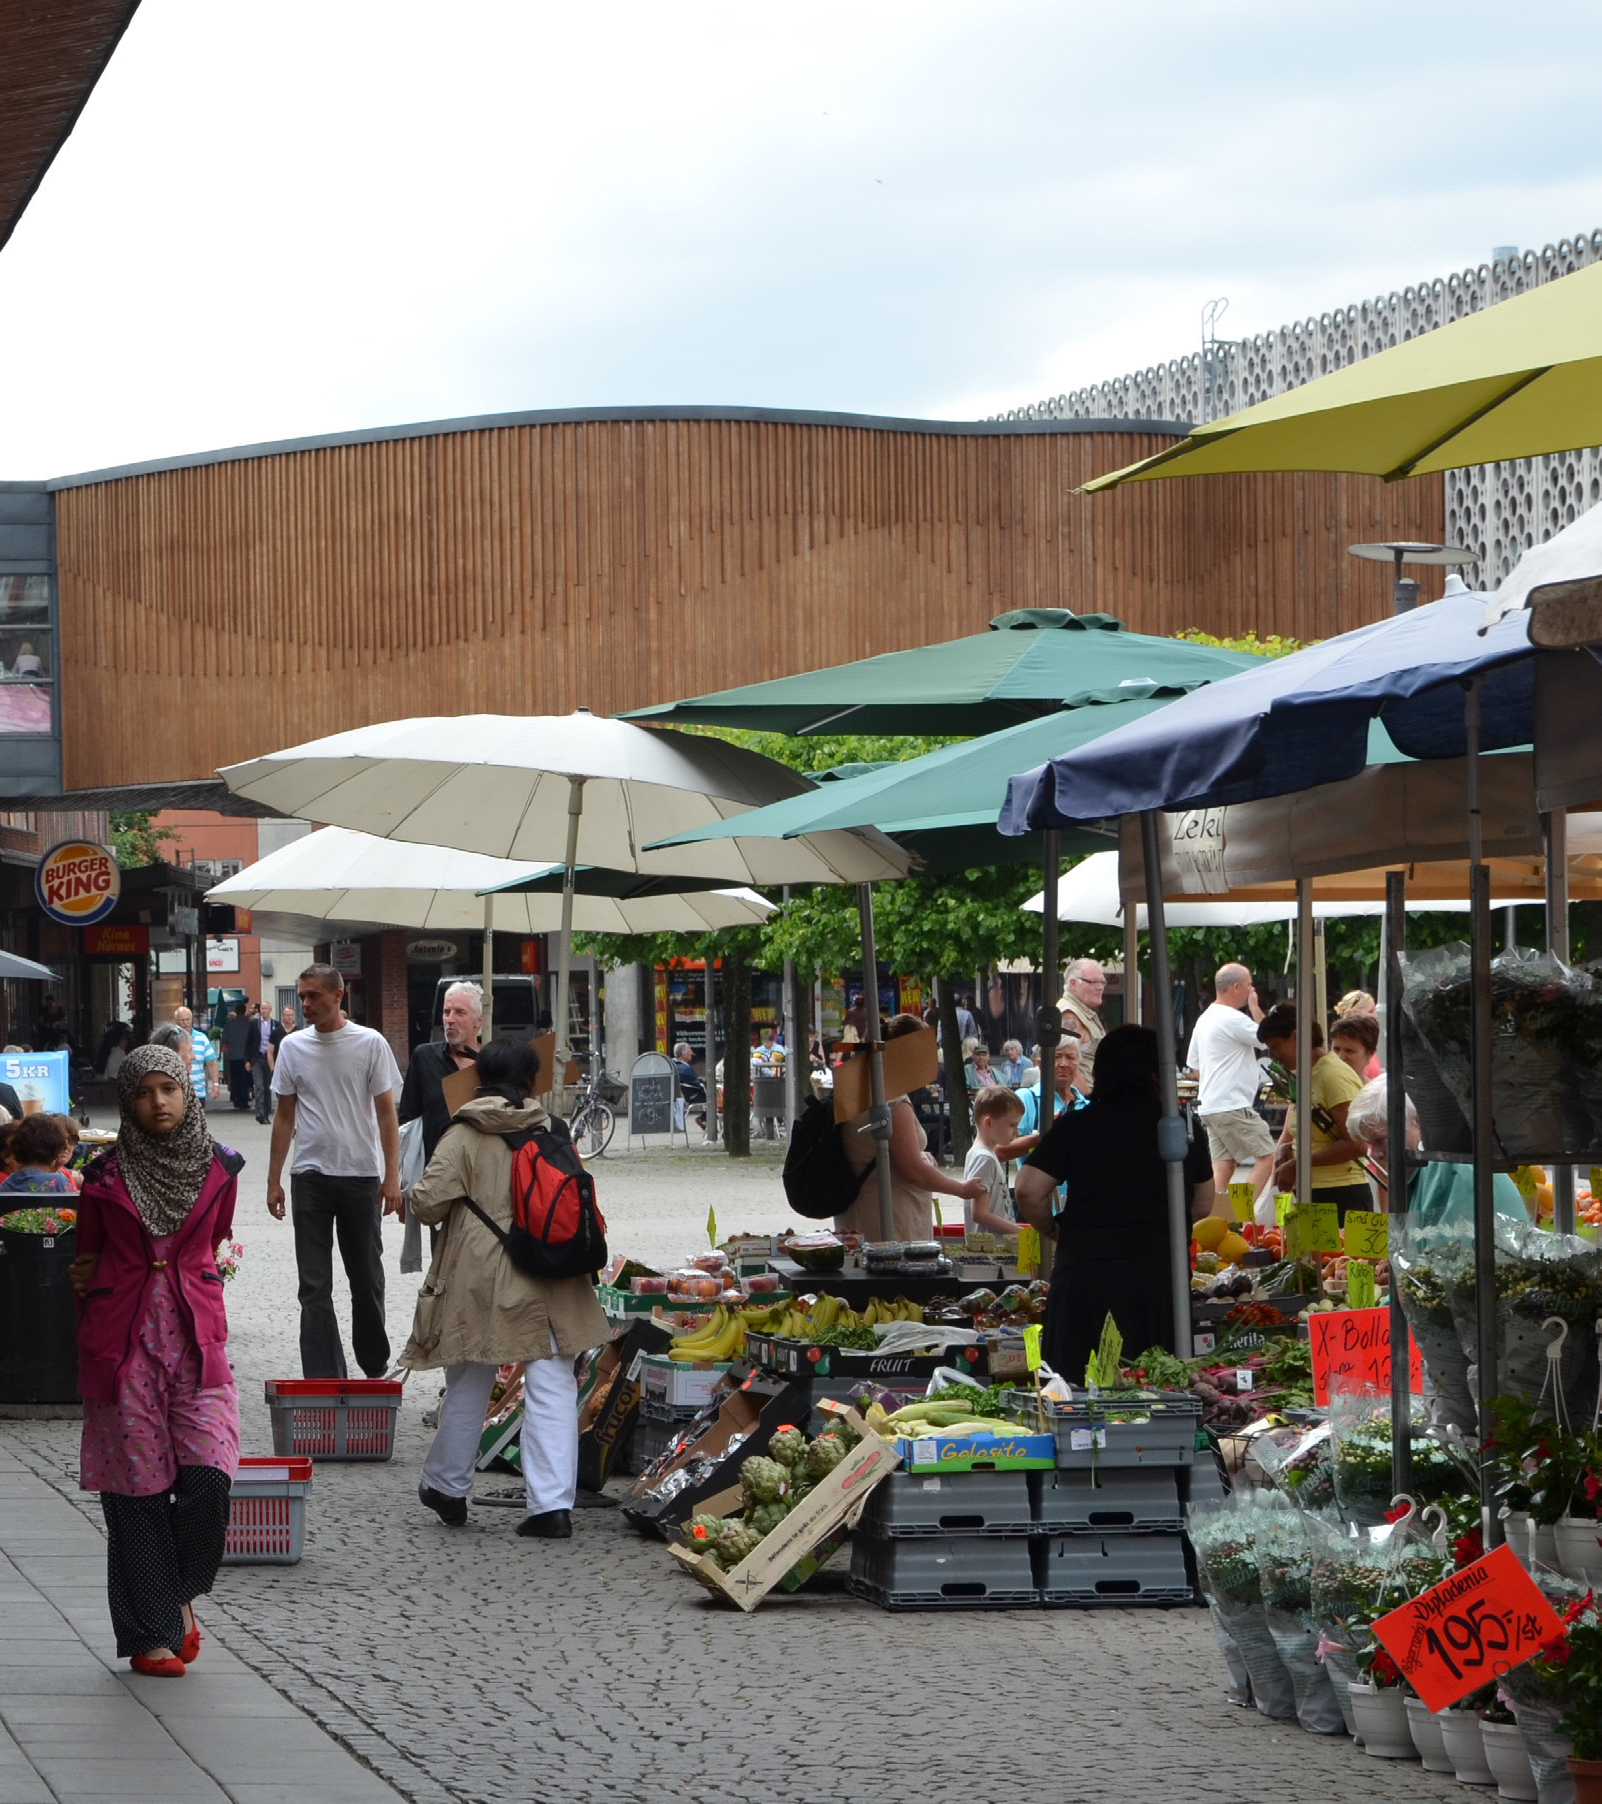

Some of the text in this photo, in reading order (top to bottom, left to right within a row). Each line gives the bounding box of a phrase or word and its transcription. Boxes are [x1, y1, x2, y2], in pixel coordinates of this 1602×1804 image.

[1174, 808, 1221, 840] Zeki
[45, 856, 109, 885] BURGER
[47, 871, 111, 907] KING
[102, 928, 130, 940] Kina
[869, 1358, 915, 1373] FRUIT
[940, 1441, 1027, 1461] Golosito
[1408, 1566, 1489, 1621] Dipladenia
